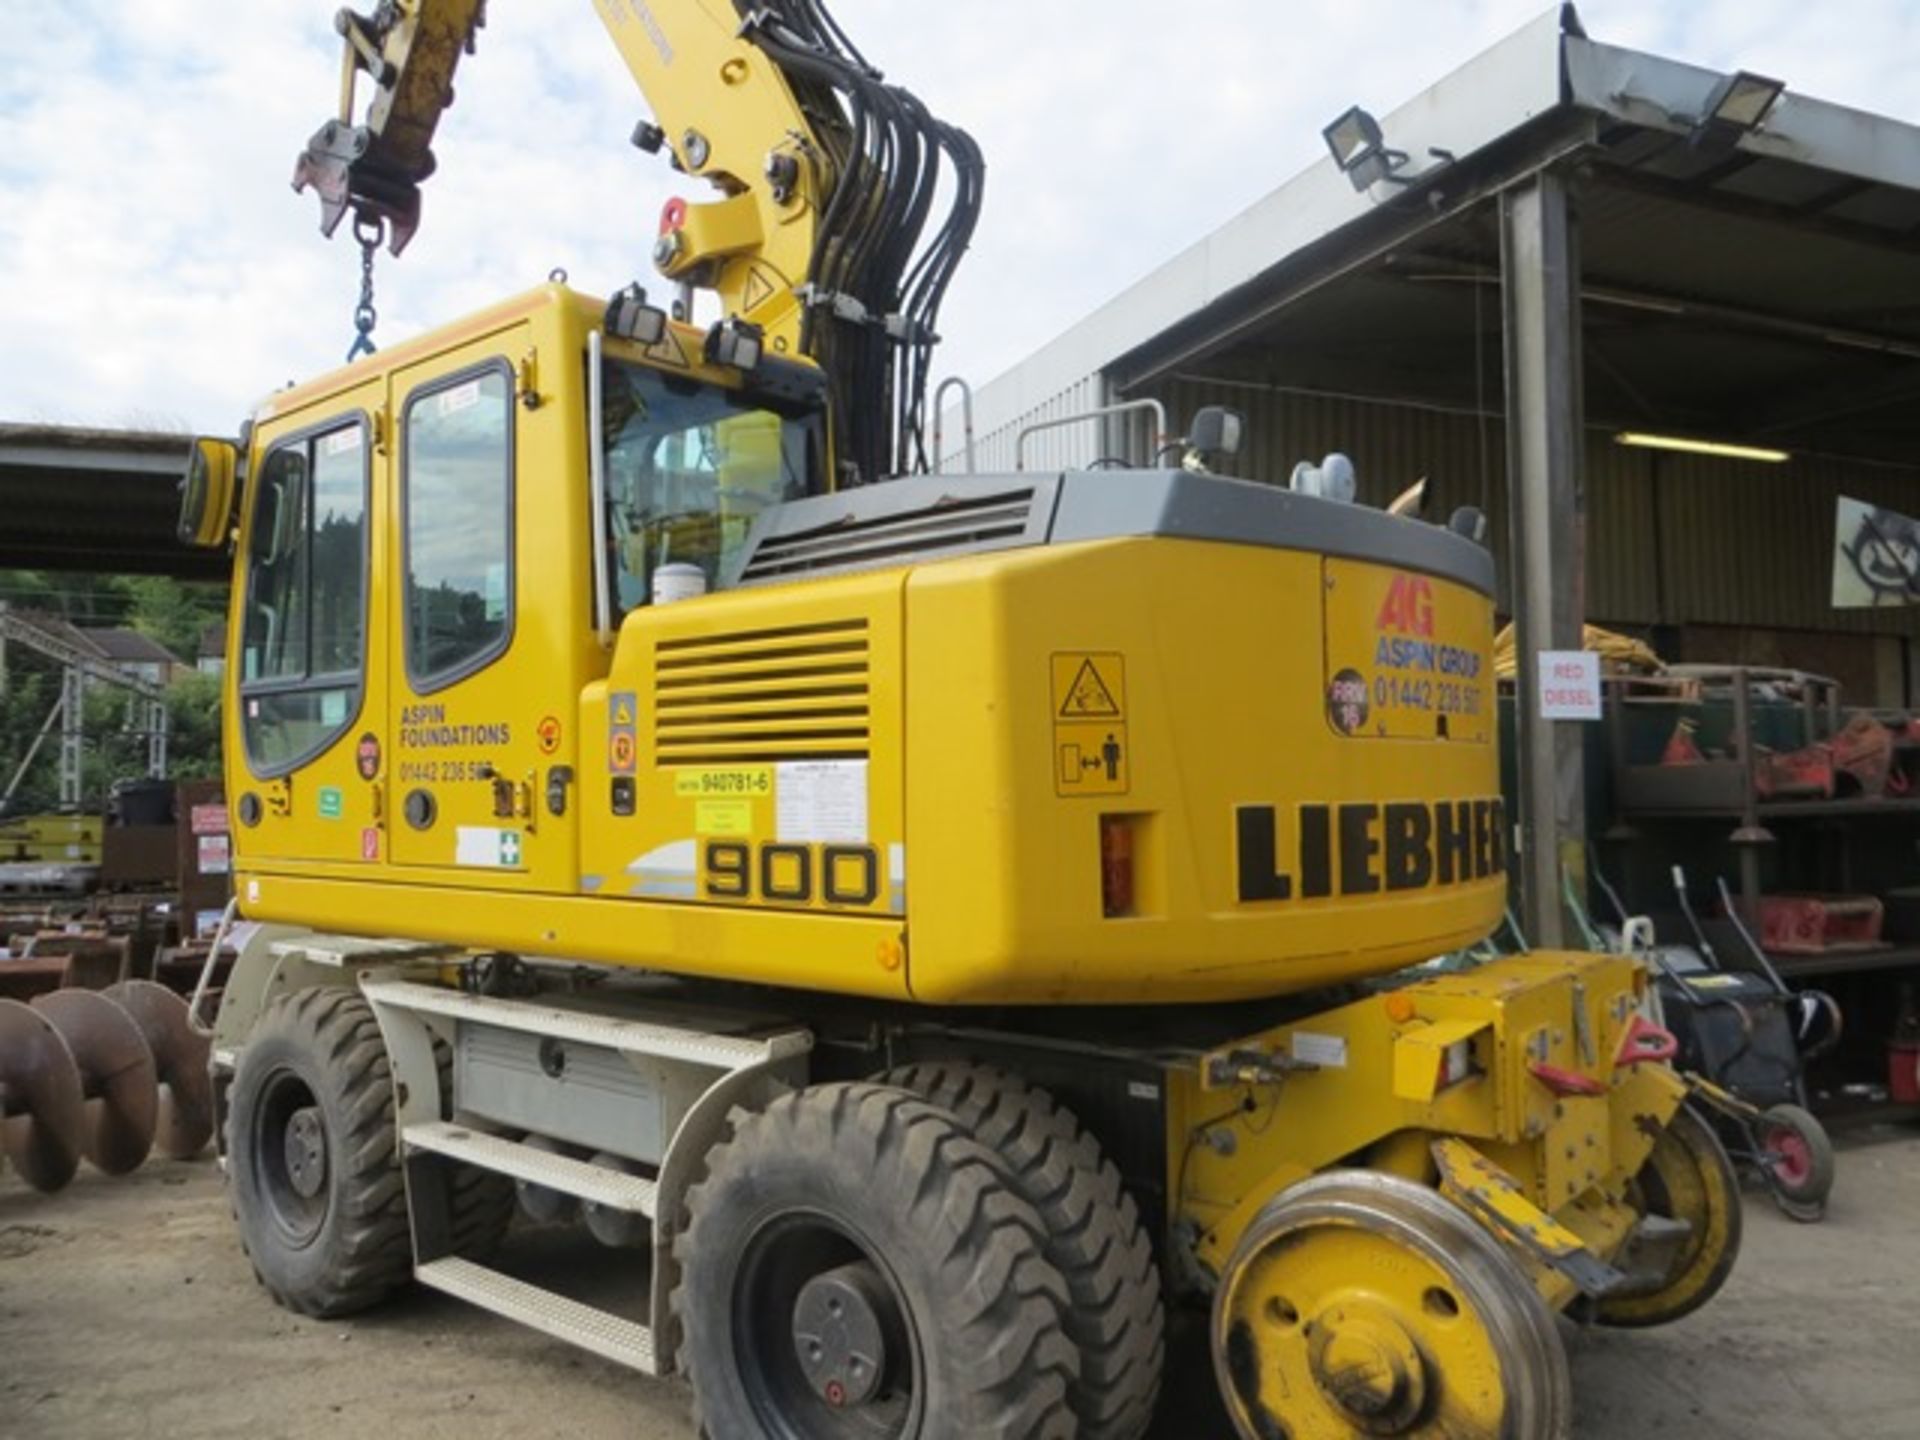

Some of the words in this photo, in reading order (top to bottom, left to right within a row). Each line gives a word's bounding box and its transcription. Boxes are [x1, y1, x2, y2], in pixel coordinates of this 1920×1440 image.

[1377, 574, 1434, 636] AG
[1375, 635, 1435, 671] ASPIN
[1439, 644, 1480, 678] GROUP
[1554, 663, 1584, 679] RED
[1545, 688, 1594, 706] DIESEL
[402, 704, 445, 724] ASPIN
[400, 723, 510, 748] FOUNDATIONS
[401, 761, 437, 782] 01442
[705, 845, 875, 905] 900
